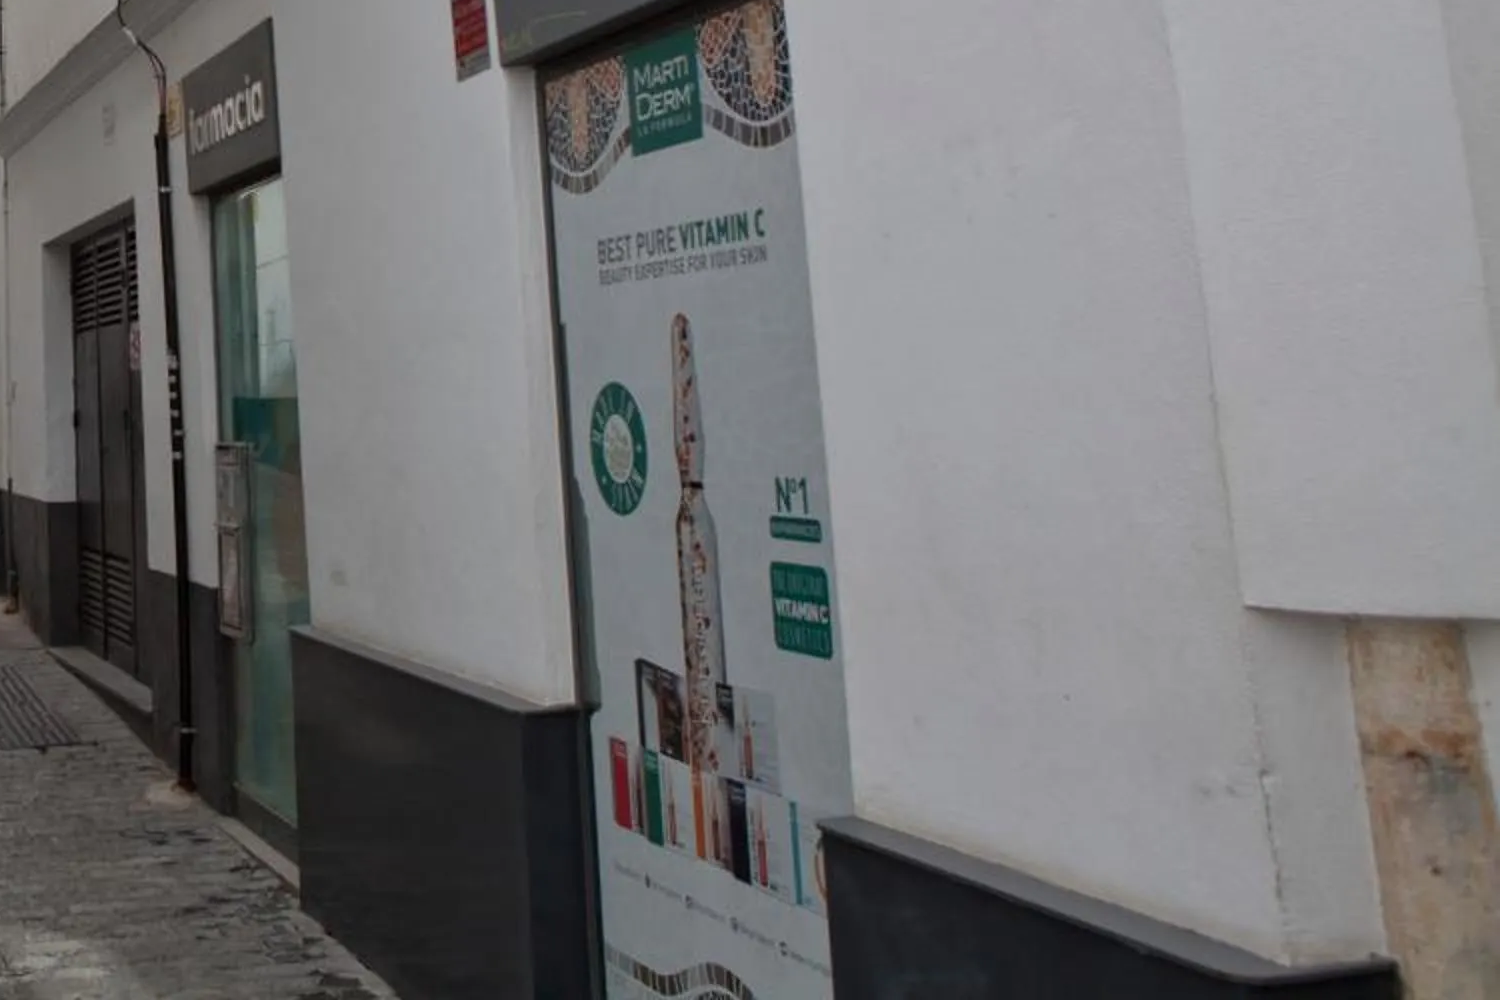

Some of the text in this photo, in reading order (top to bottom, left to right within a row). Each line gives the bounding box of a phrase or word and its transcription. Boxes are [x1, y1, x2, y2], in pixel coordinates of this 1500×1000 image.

[633, 55, 690, 94] MARTI
[188, 75, 266, 157] farmacia
[597, 207, 766, 265] BEST PURE VITAMIN C
[635, 256, 686, 282] EXPERTISE
[688, 253, 709, 273] FOR
